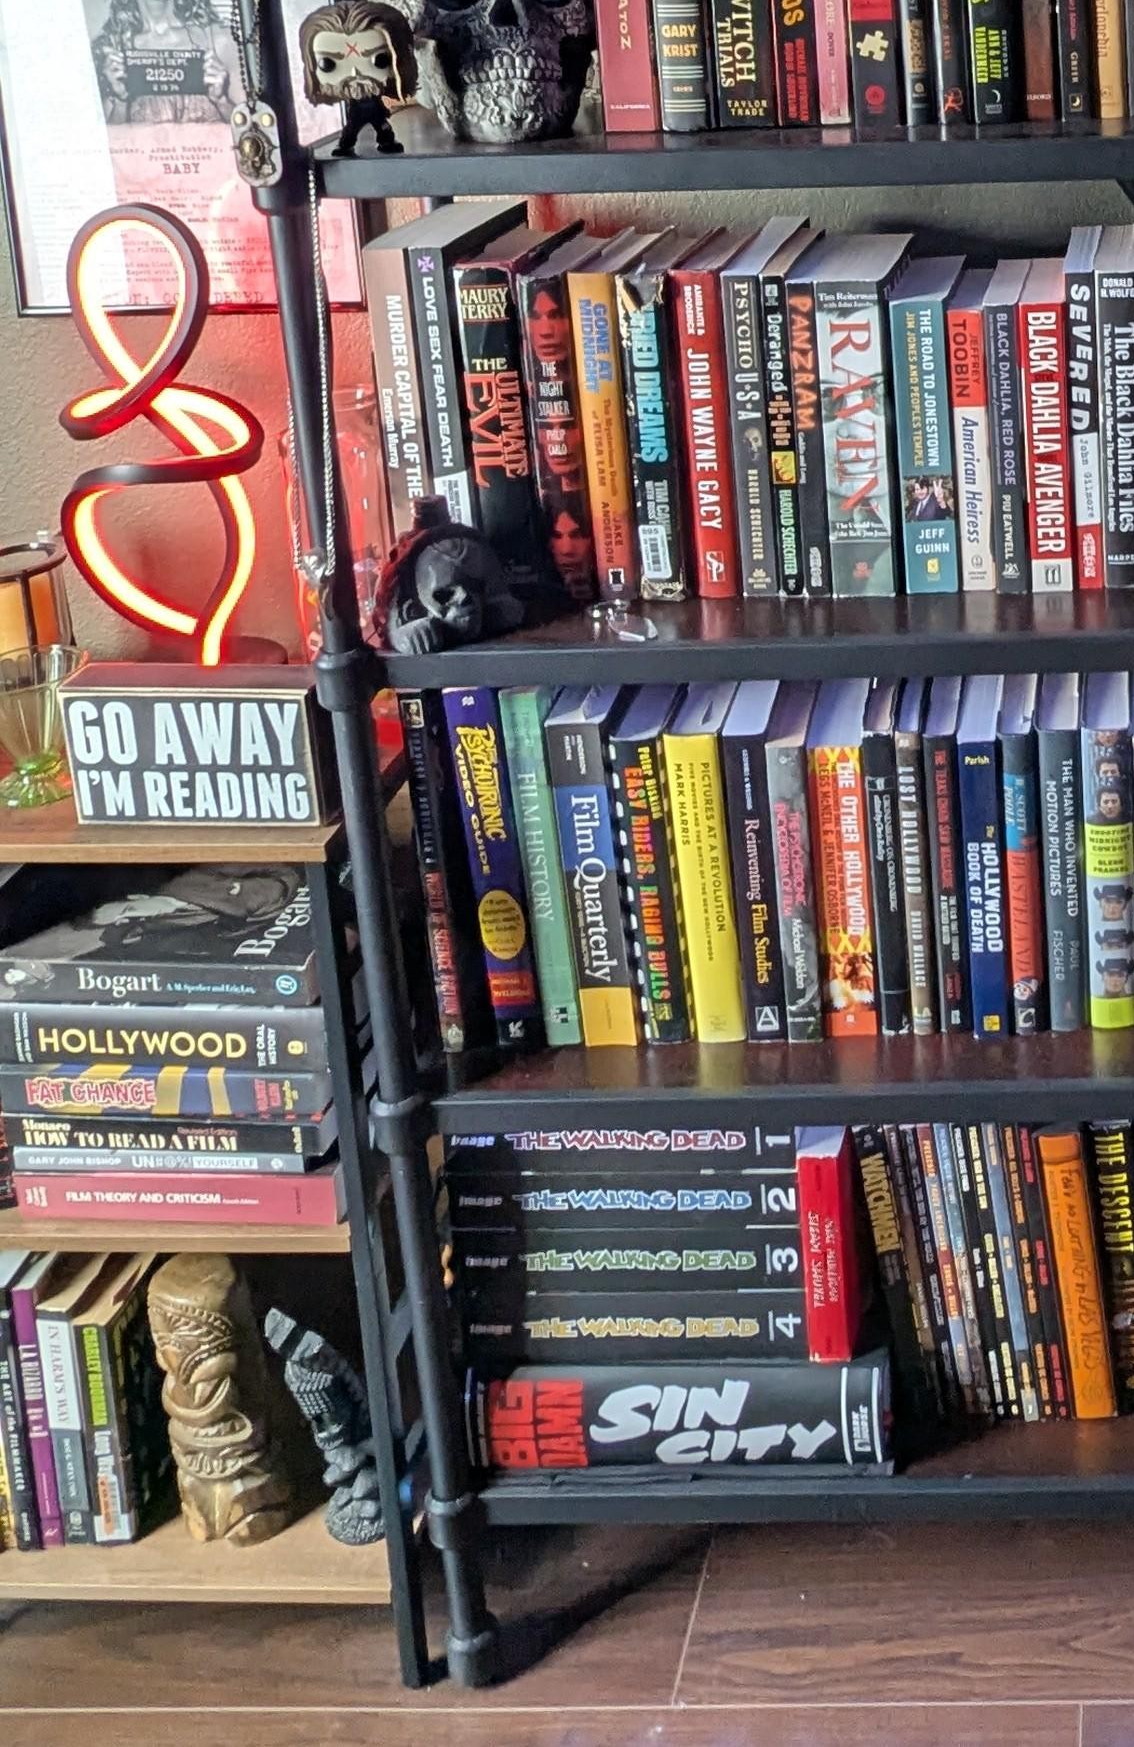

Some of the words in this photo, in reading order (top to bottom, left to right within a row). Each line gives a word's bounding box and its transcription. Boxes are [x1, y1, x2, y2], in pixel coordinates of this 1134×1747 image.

[662, 25, 696, 38] GARY
[662, 44, 697, 57] KRIST
[715, 18, 735, 88] TRIALS
[145, 68, 184, 82] 21250
[162, 163, 201, 175] BABY
[423, 276, 435, 322] LOVE
[385, 295, 408, 365] MURDER
[427, 326, 440, 362] SEX
[920, 333, 933, 363] ROAD
[1027, 311, 1059, 375] BLACK
[1070, 284, 1094, 431] SEVERED
[431, 365, 445, 407] FEAR
[688, 349, 712, 402] JOHN
[788, 295, 817, 430] PANZRAM
[952, 319, 971, 399] TOOBIN
[394, 366, 418, 432] CAPITAL
[829, 319, 878, 512] RAVEN
[923, 384, 939, 467] JONESTOWN
[1030, 380, 1062, 456] DAHLIA
[436, 412, 453, 467] DEATH
[690, 406, 717, 474] WAYNE
[961, 415, 981, 485] American
[695, 480, 722, 531] GACY
[965, 489, 983, 544] Heiress
[1033, 461, 1067, 554] AVENGER
[915, 542, 949, 554] GUINN
[918, 529, 945, 540] JEFF
[68, 700, 138, 765] GO
[154, 702, 298, 766] AWAY
[77, 770, 136, 816] I'M
[143, 771, 310, 819] READING
[571, 794, 599, 854] Film
[967, 842, 980, 882] BOOK
[574, 858, 618, 982] Quarterly
[982, 842, 1003, 953] HOLLYWOOD
[969, 908, 984, 954] DEATH
[77, 967, 162, 997] Bogart
[38, 1028, 247, 1058] HOLLYWOOD
[25, 1079, 64, 1104] FAT
[70, 1080, 156, 1104] CHANCE
[589, 1378, 750, 1443] SIN
[656, 1419, 837, 1464] CITY
